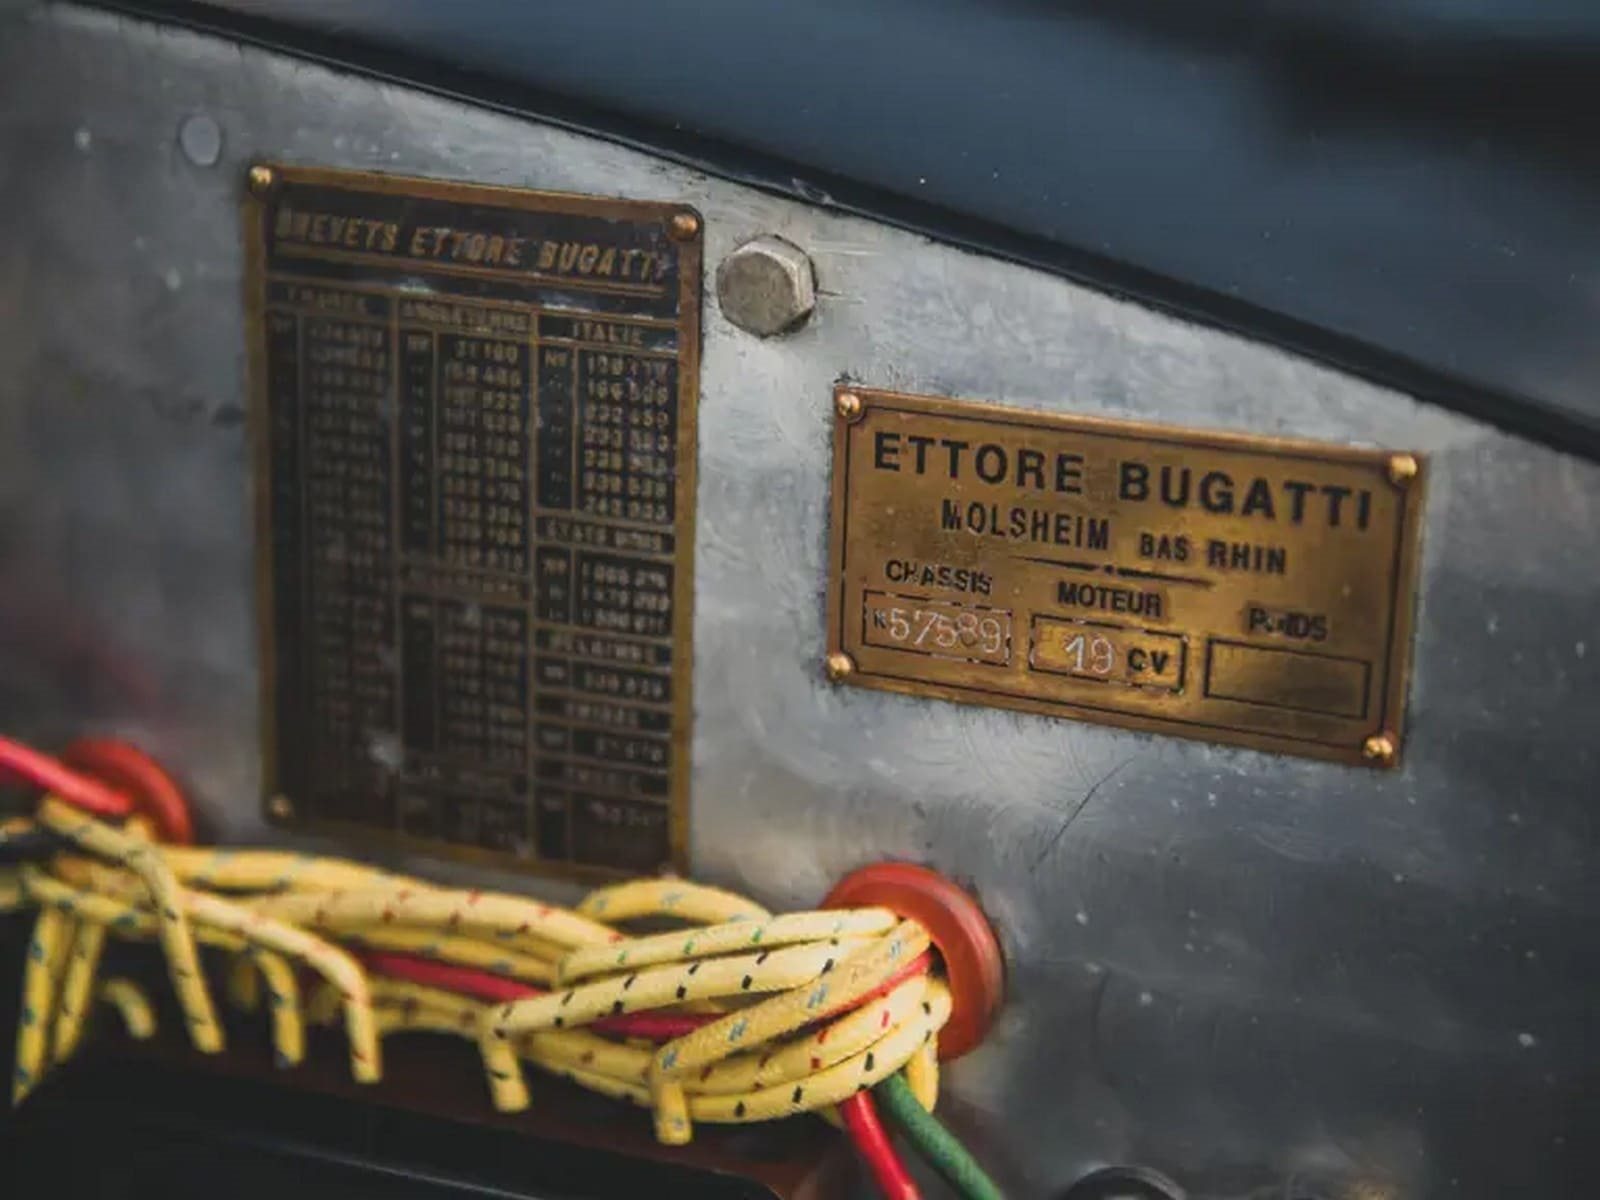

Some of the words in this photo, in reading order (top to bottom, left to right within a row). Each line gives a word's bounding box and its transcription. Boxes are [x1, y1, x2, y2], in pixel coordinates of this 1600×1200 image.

[410, 225, 521, 265] ETTORE
[572, 320, 645, 345] ITALIE
[874, 430, 1085, 495] ETTORE
[1118, 460, 1372, 531] BUGATTI
[941, 498, 1109, 551] MOLSHEIM
[1139, 532, 1189, 562] BAS
[1208, 539, 1287, 575] RHIN
[885, 559, 993, 595] CHASSIS
[1057, 580, 1162, 618] MOTEUR
[1064, 632, 1113, 675] 19
[1127, 647, 1169, 675] CV
